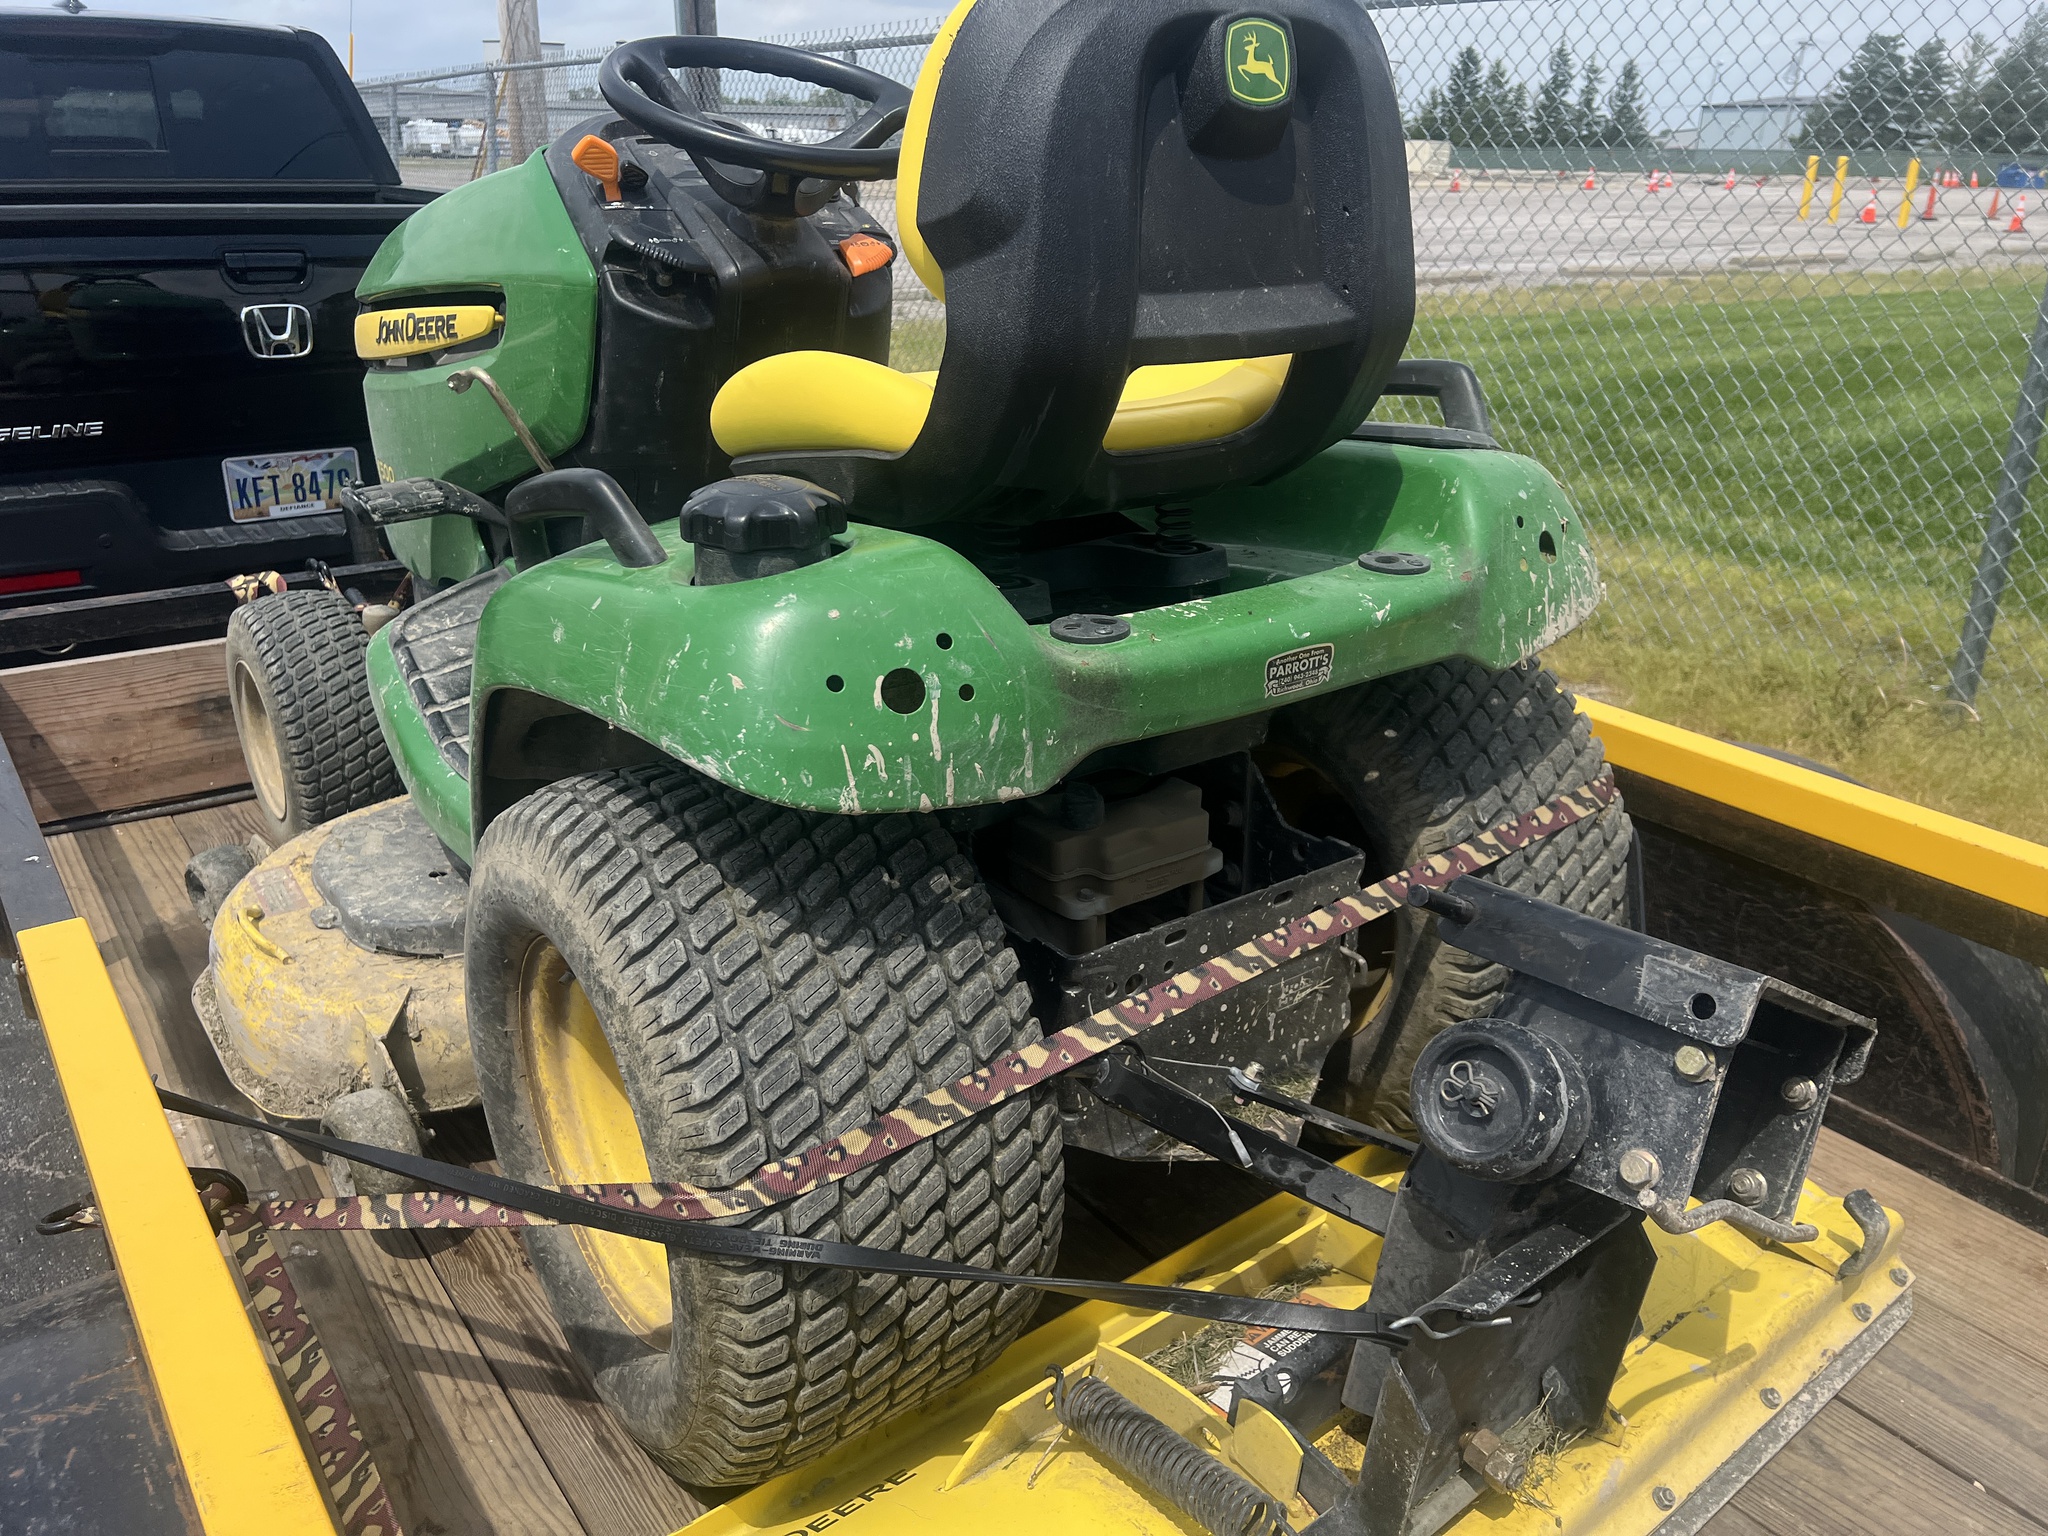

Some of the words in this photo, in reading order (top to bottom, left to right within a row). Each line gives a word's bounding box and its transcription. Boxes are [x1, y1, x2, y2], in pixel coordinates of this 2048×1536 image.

[376, 316, 405, 345] JOHN
[406, 313, 458, 341] DEERE
[235, 474, 280, 509] KFT
[1269, 653, 1329, 679] PARROTT'S
[1276, 655, 1298, 666] Another
[1305, 678, 1318, 686] Ohio
[502, 1183, 540, 1200] CRACKED
[543, 1194, 561, 1207] CUT
[565, 1200, 574, 1209] IF
[576, 1204, 617, 1221] DISCARD
[621, 1214, 681, 1234] DISCONNECT
[686, 1227, 708, 1237] AND
[630, 1225, 676, 1242] GLASSES
[713, 1231, 773, 1246] TIE-DOWN
[681, 1235, 723, 1249] SAFETY
[726, 1241, 821, 1259] WARNING-WEAR
[778, 1239, 824, 1251] DURING
[1270, 1336, 1290, 1352] CAN
